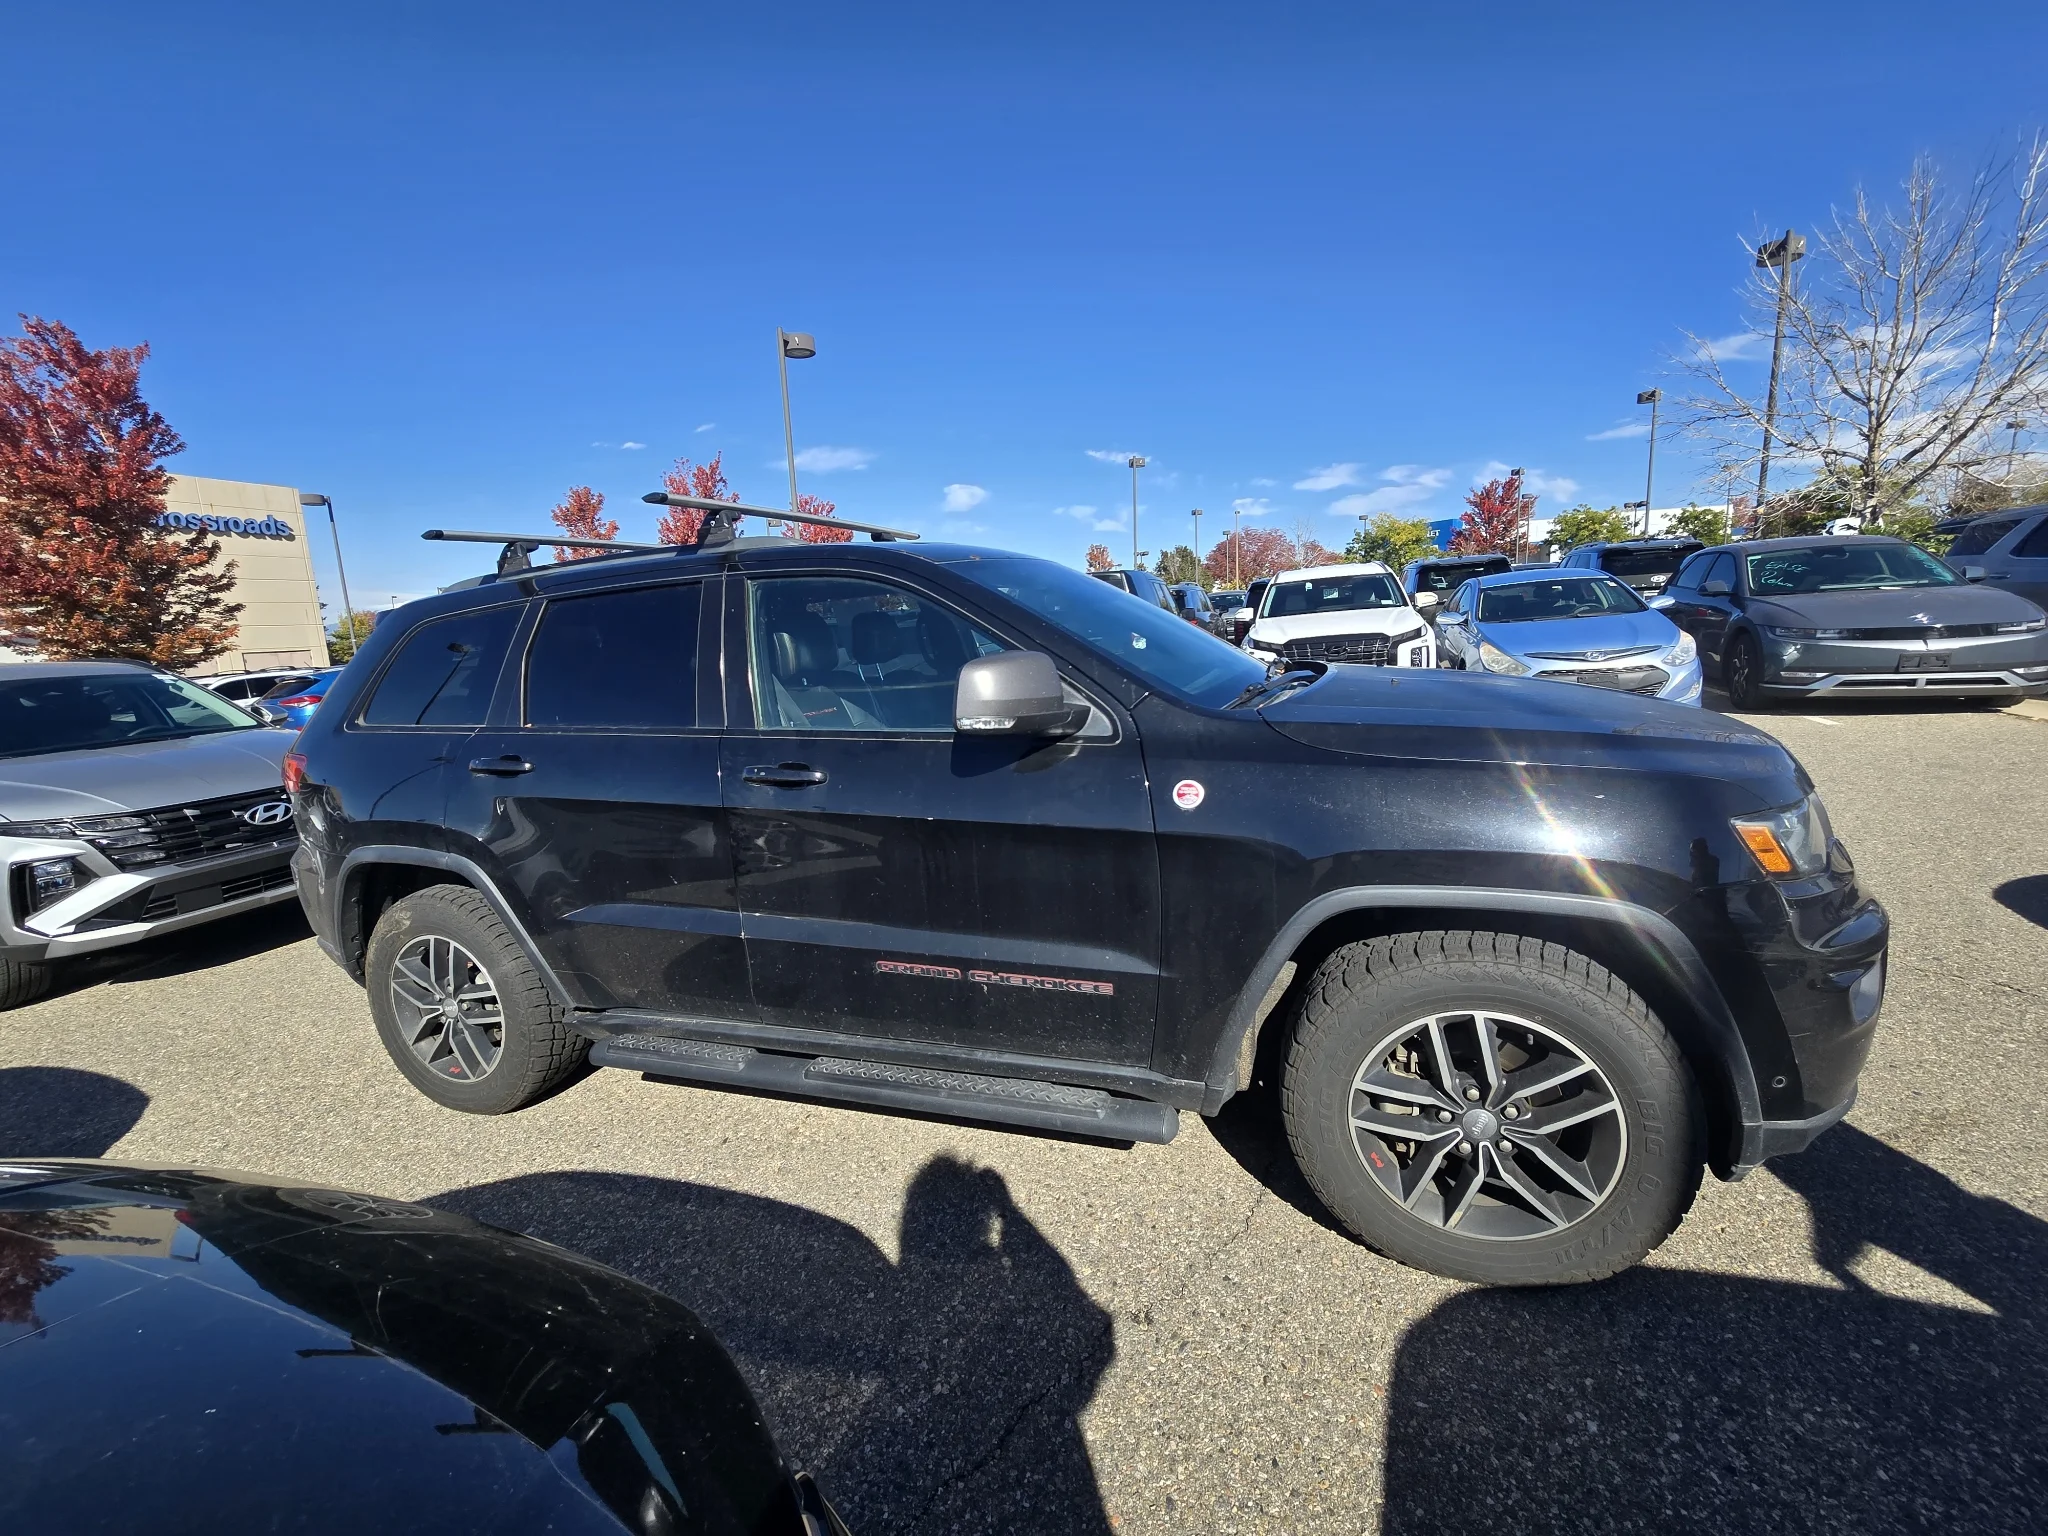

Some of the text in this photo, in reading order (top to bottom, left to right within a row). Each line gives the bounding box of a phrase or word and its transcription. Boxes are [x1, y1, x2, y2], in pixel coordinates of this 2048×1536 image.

[150, 512, 289, 537] rossroads
[875, 960, 1114, 996] GRAND CHEROKEE
[1472, 1114, 1488, 1136] Jeep
[1636, 1099, 1665, 1157] BIG
